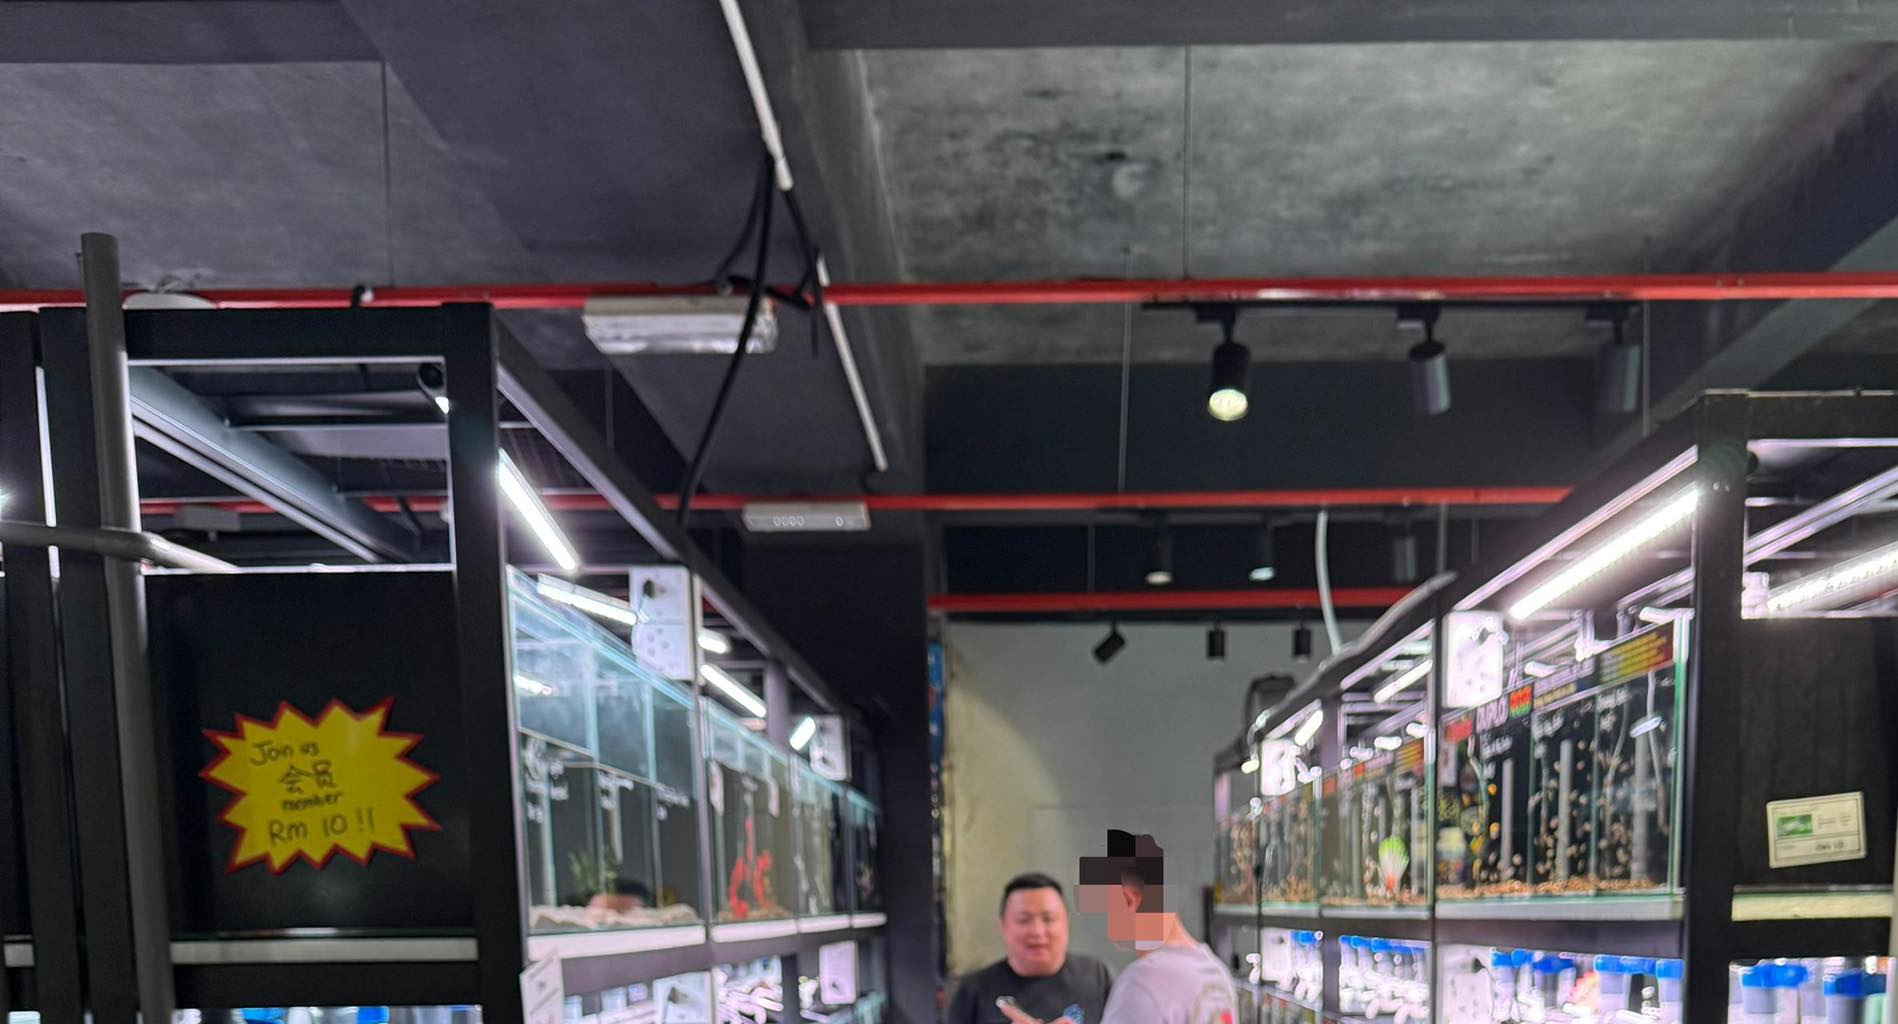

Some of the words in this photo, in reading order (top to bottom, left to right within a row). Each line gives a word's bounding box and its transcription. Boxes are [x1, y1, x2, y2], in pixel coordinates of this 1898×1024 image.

[250, 741, 294, 767] Join
[299, 741, 320, 757] us
[282, 792, 343, 811] member
[323, 814, 348, 836] 10
